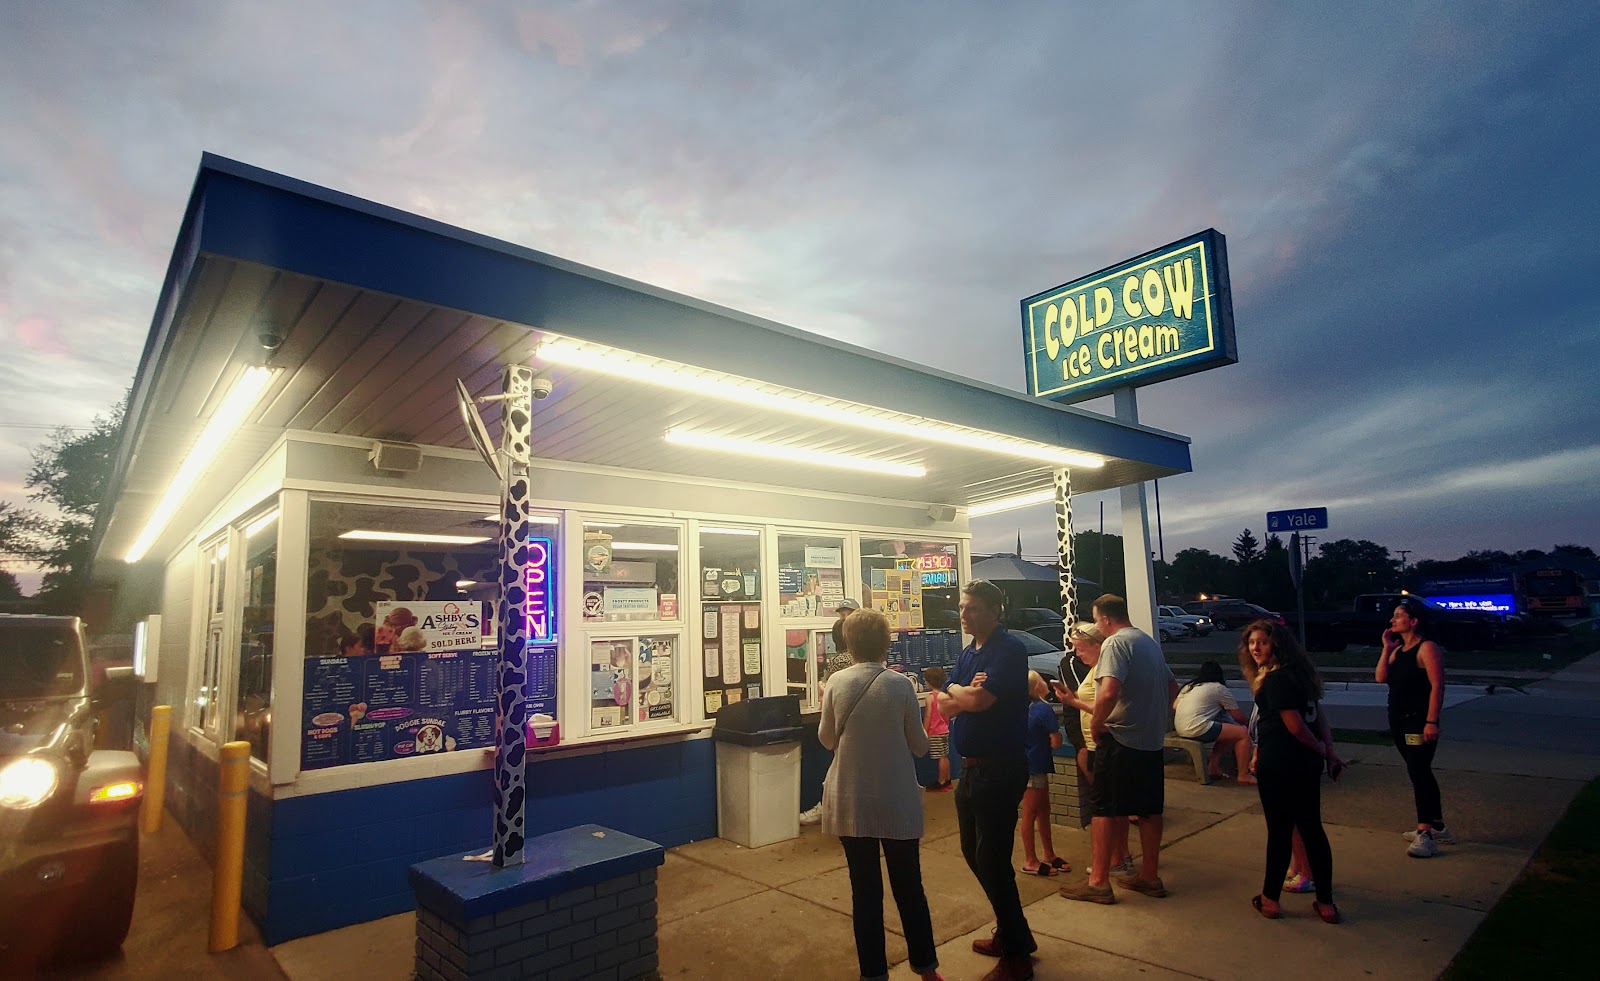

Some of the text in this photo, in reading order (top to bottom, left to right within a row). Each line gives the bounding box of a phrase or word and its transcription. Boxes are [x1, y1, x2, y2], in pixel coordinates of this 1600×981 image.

[1044, 258, 1194, 360] COLD COW
[1097, 324, 1179, 370] Cream
[1287, 513, 1316, 526] Yale
[527, 543, 546, 637] OPEN
[421, 613, 480, 630] ASHBY'S
[431, 636, 476, 648] SOLD HERE
[395, 719, 420, 732] DOGGIE
[421, 718, 446, 727] SUNDAE
